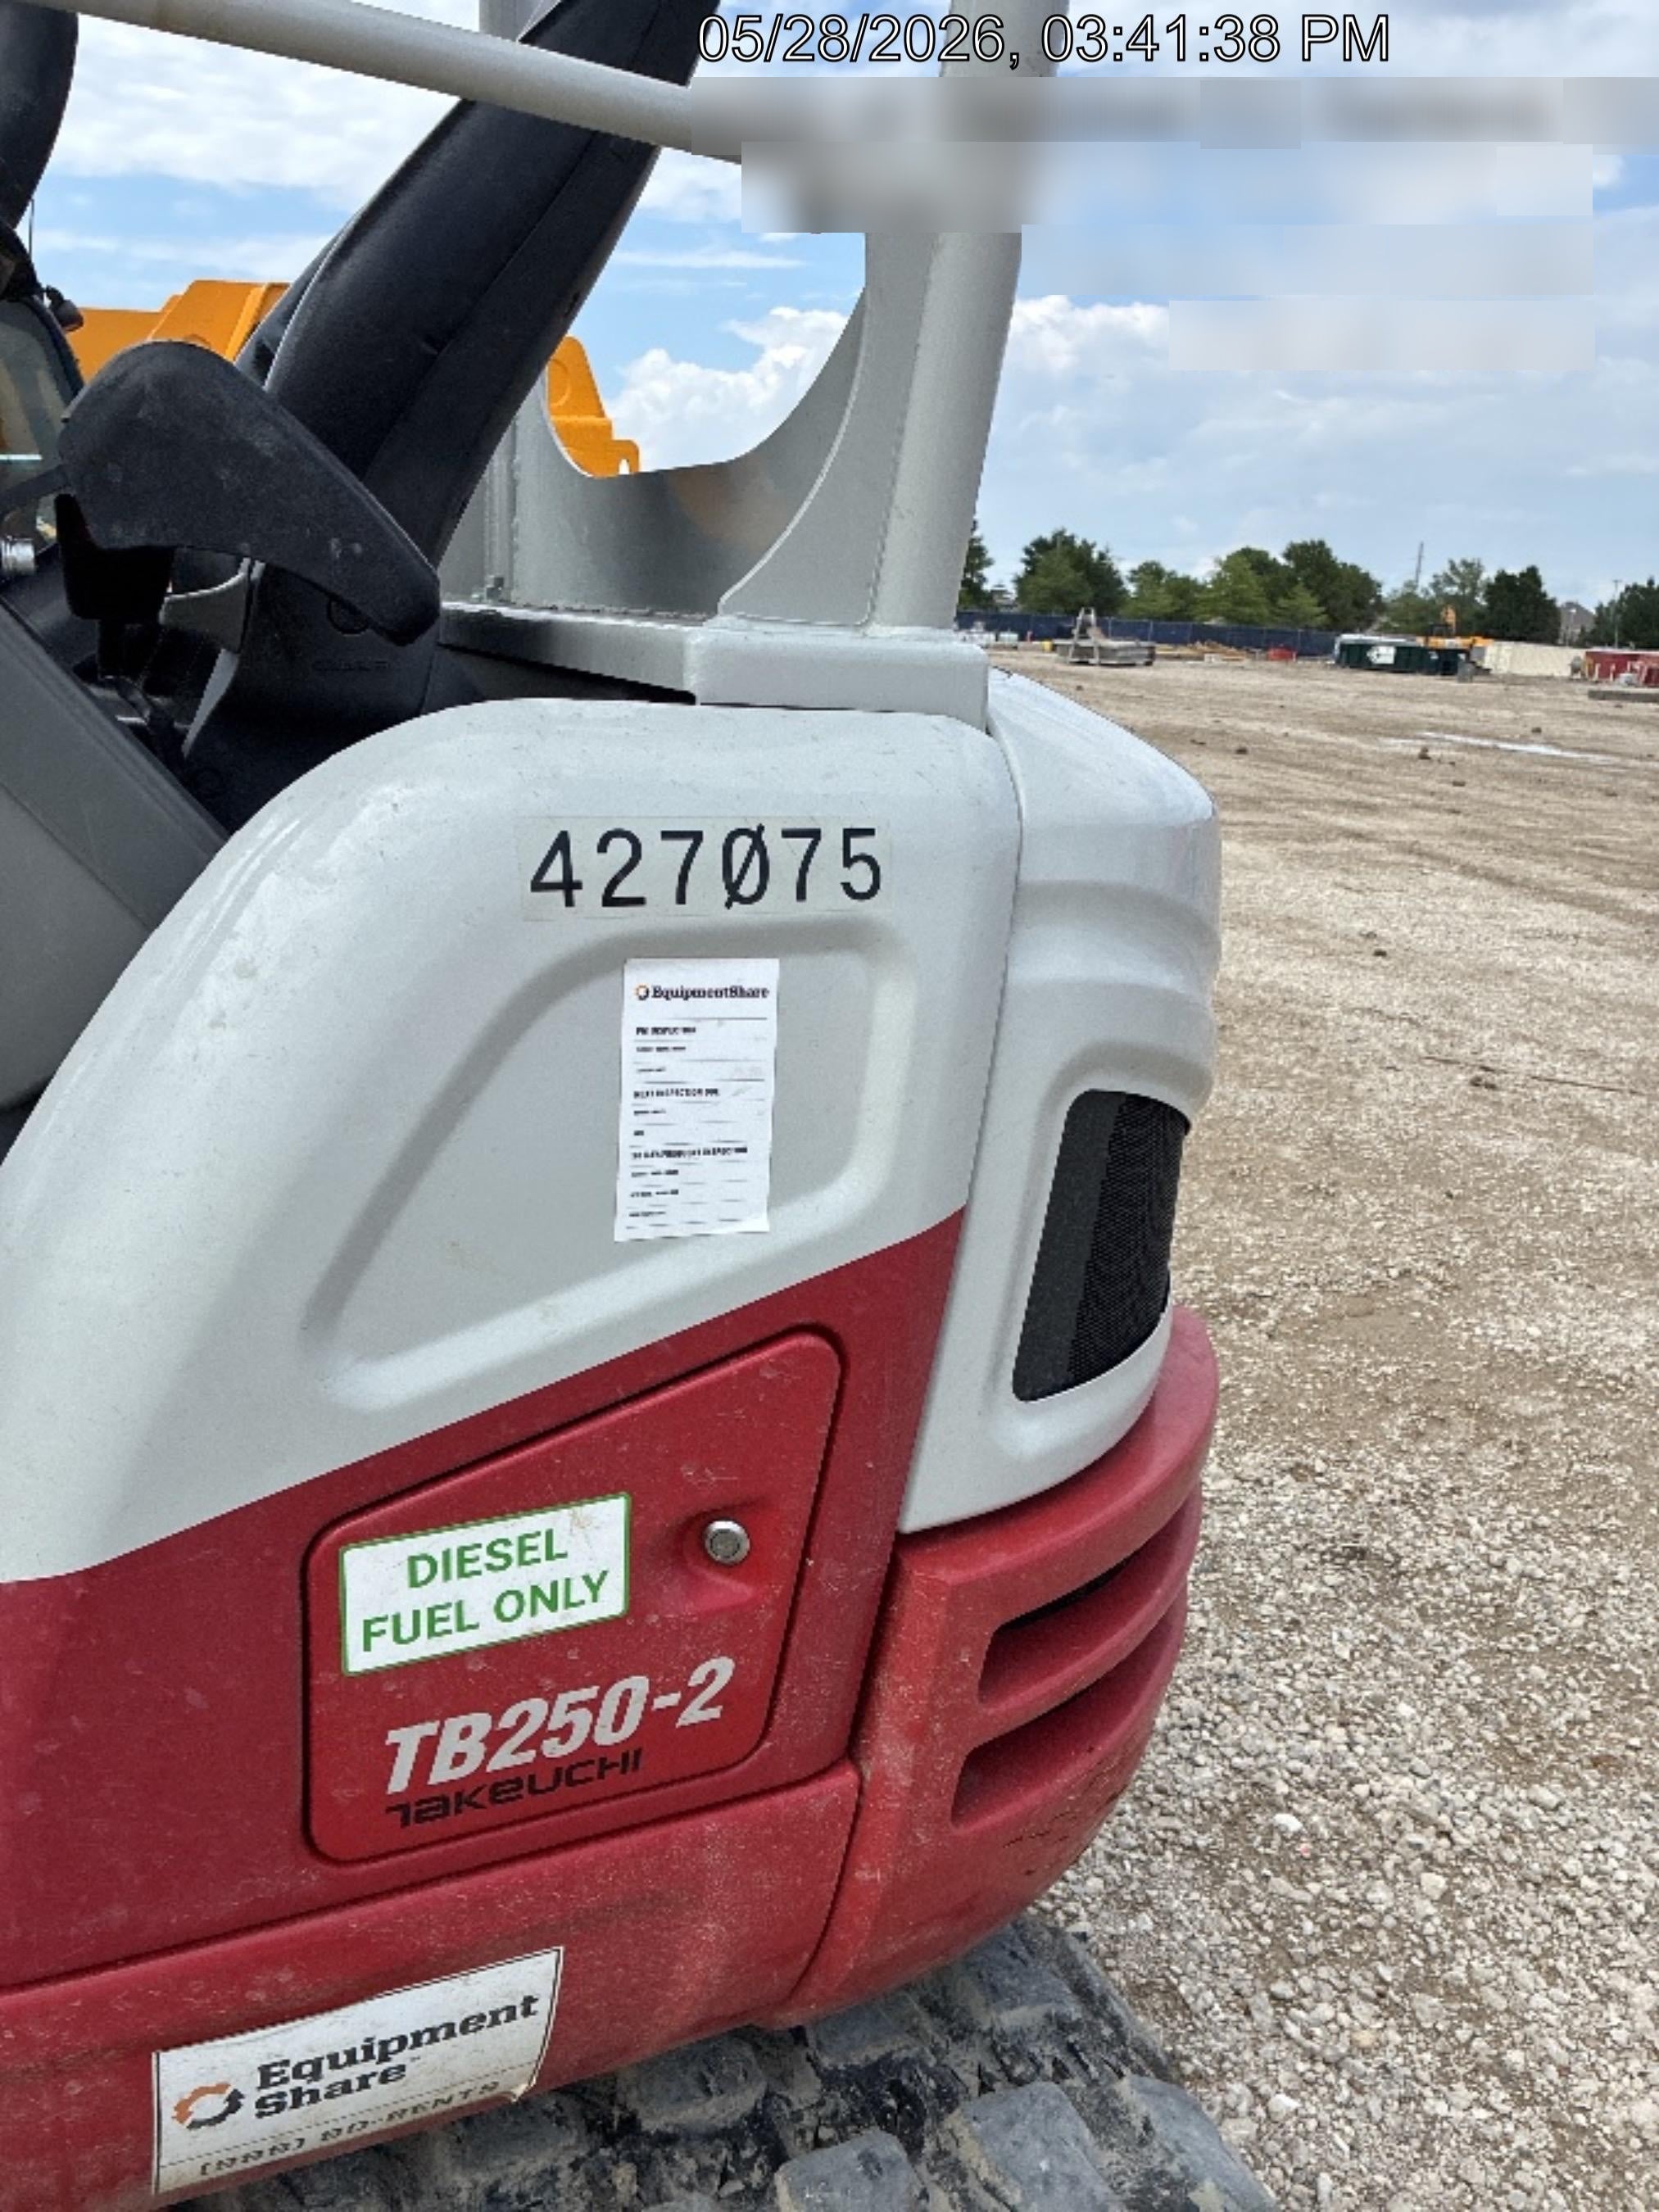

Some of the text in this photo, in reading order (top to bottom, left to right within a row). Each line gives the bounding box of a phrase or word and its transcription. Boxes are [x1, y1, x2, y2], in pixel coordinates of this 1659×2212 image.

[651, 985, 770, 1001] EquipmentShare
[407, 1529, 568, 1589] DIESEL
[362, 1570, 610, 1652] FUEL ONLY
[385, 1656, 736, 1796] TB250-2
[256, 1994, 539, 2091] Equipment
[255, 2064, 407, 2119] Share
